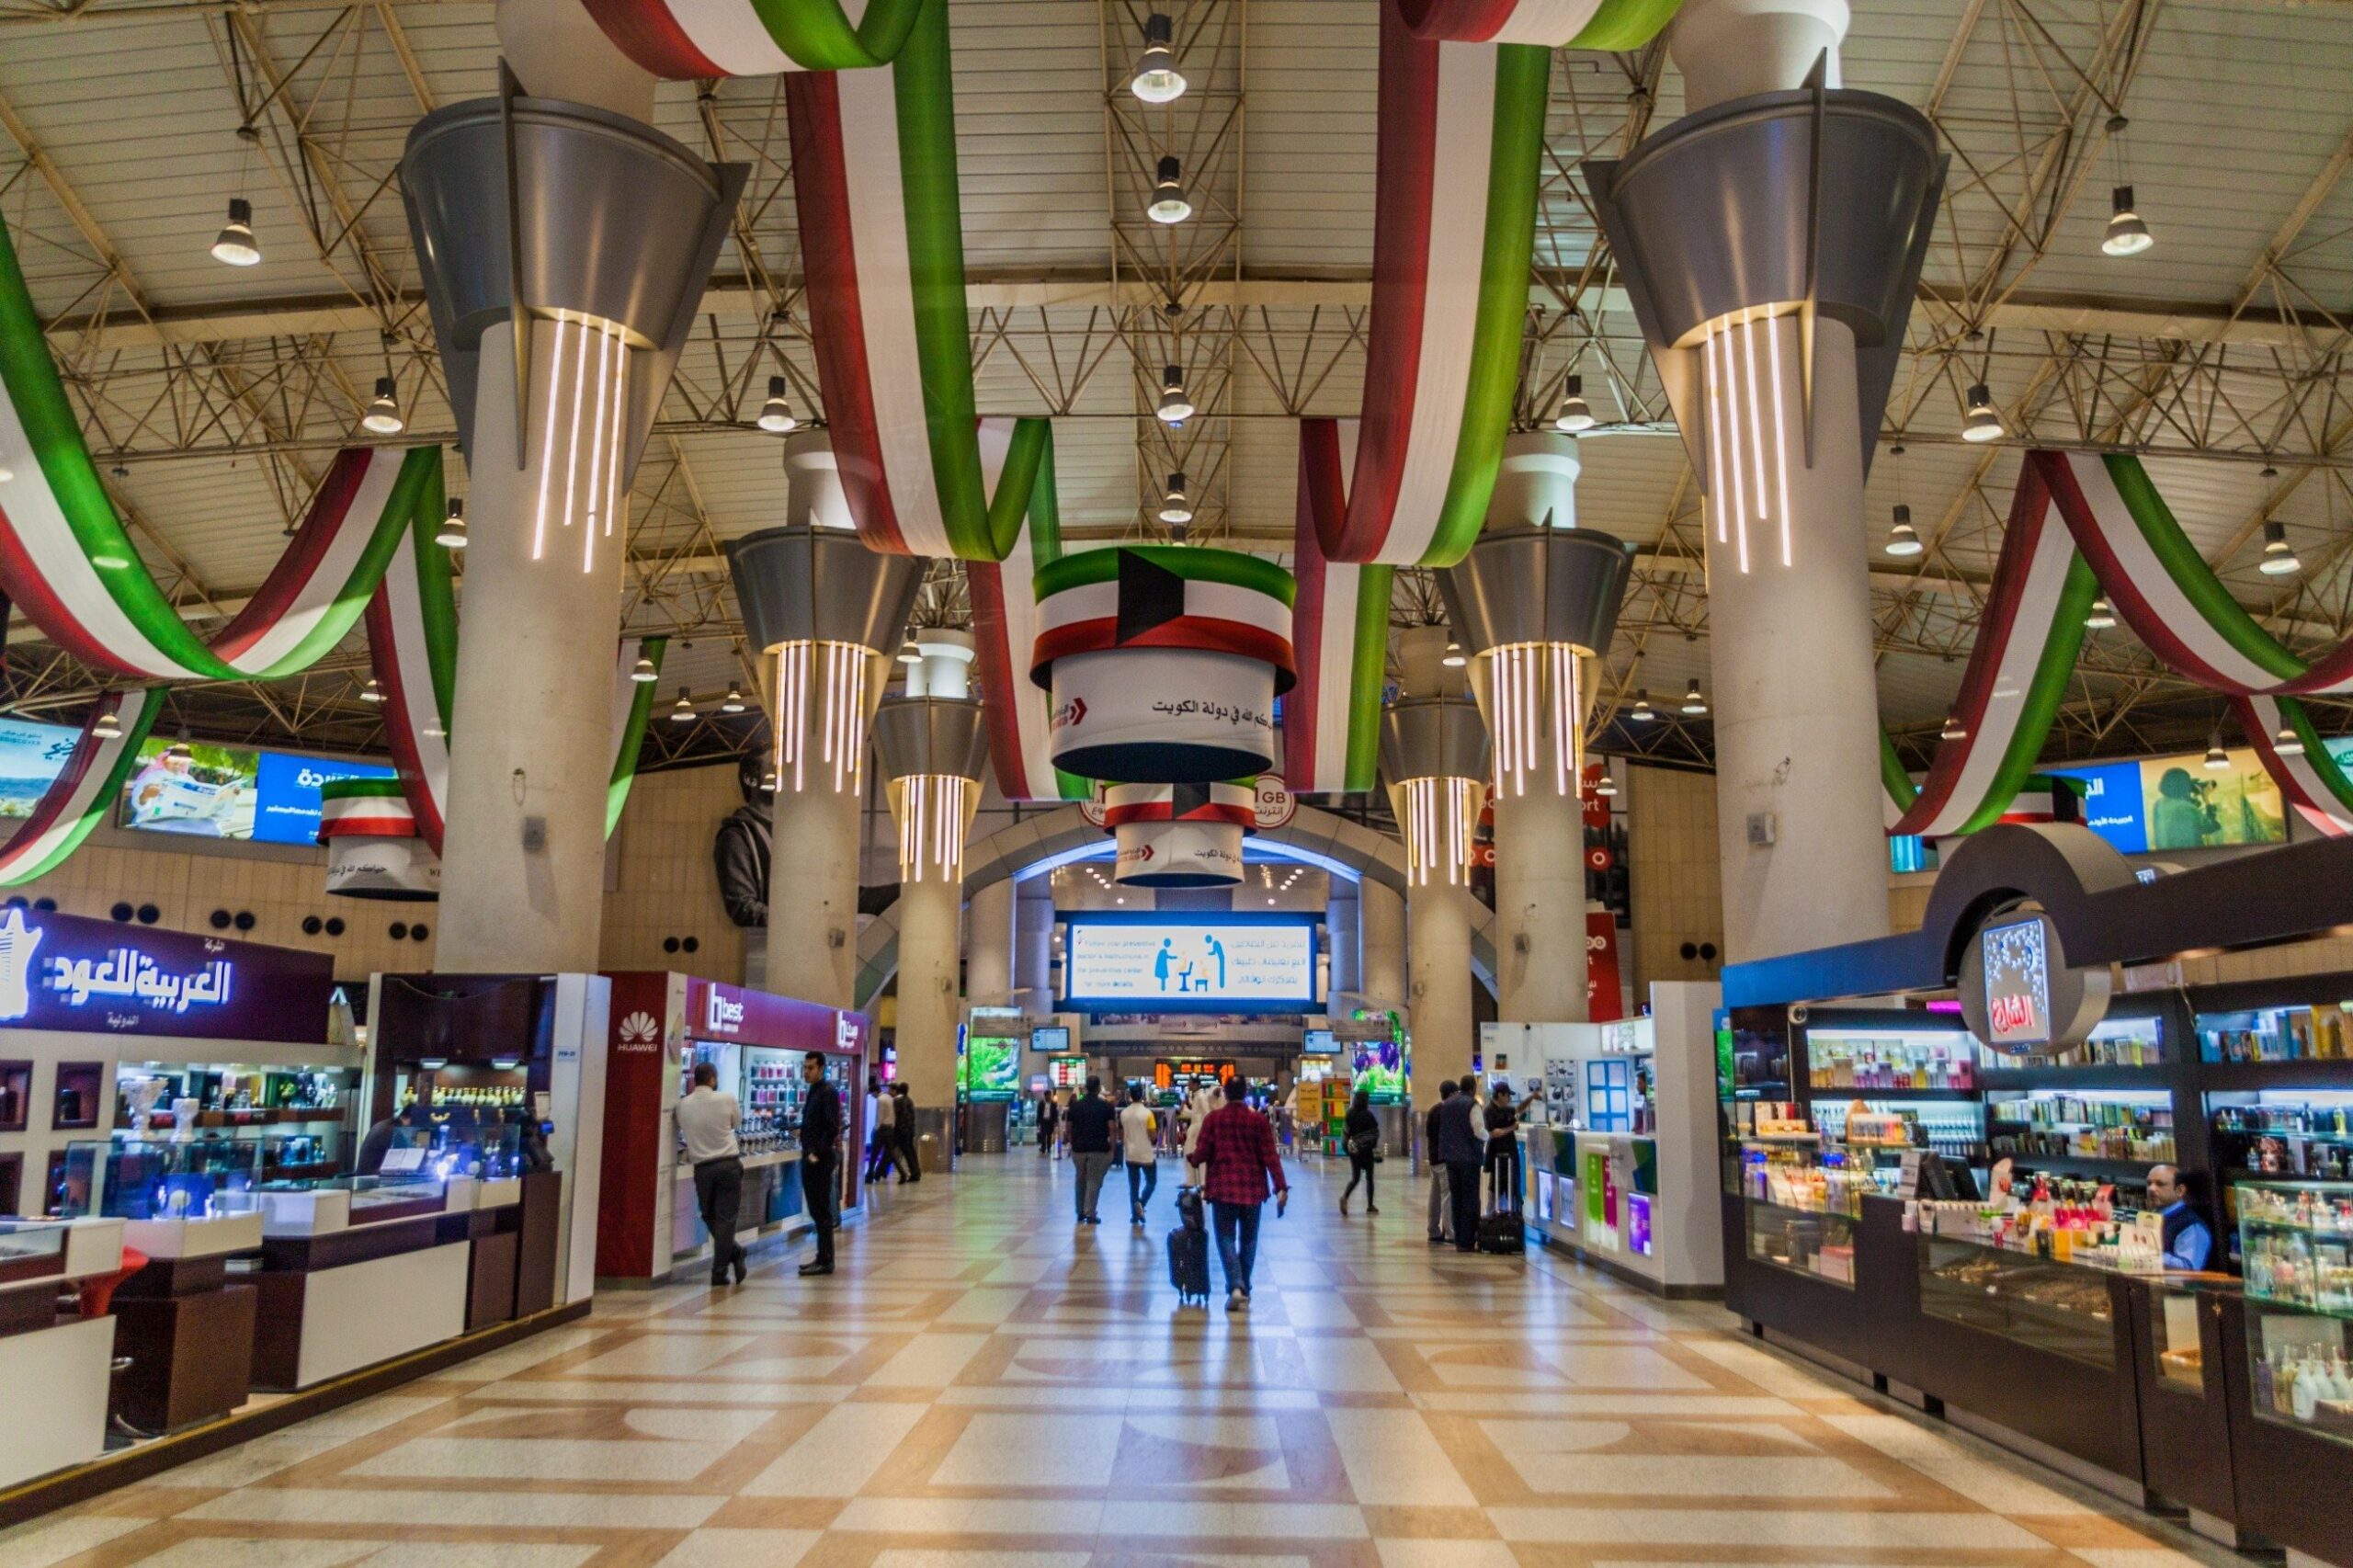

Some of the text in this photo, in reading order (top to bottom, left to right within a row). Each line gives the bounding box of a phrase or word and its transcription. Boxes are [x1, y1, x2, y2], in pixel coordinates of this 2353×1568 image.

[1152, 699, 1199, 716] الكويت
[1202, 700, 1228, 720] دولة
[1231, 705, 1239, 725] في
[1262, 791, 1286, 803] GB
[51, 948, 232, 1014] العربية للعود
[722, 997, 745, 1023] best
[617, 1042, 658, 1052] HUAWEI
